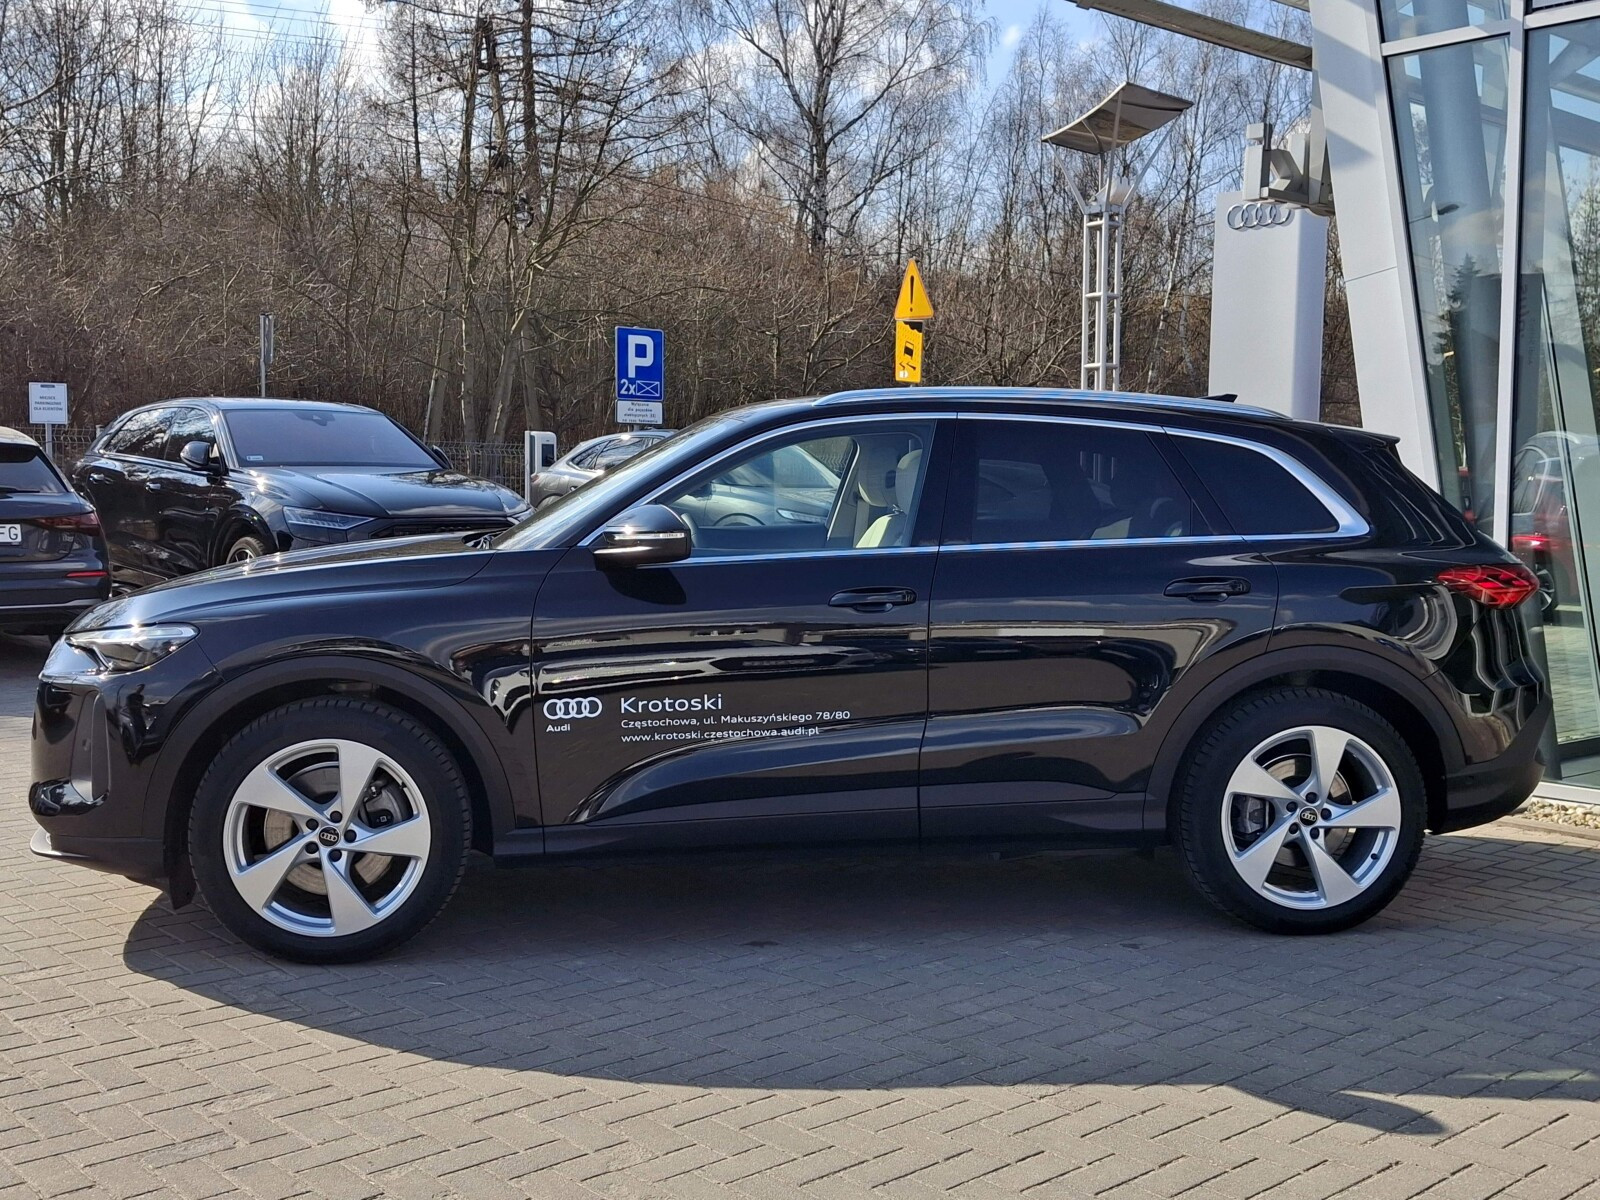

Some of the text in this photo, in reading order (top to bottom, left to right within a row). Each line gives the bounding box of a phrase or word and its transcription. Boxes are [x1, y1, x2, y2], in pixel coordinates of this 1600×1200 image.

[628, 335, 654, 378] P
[620, 379, 636, 395] 2x
[620, 693, 722, 714] Krotoski
[546, 723, 571, 733] Audi
[620, 710, 851, 729] Częstochowa, ul. Makuszyńskiego 78/80
[620, 725, 820, 743] www.krotoski.czestochowa.audi.pl
